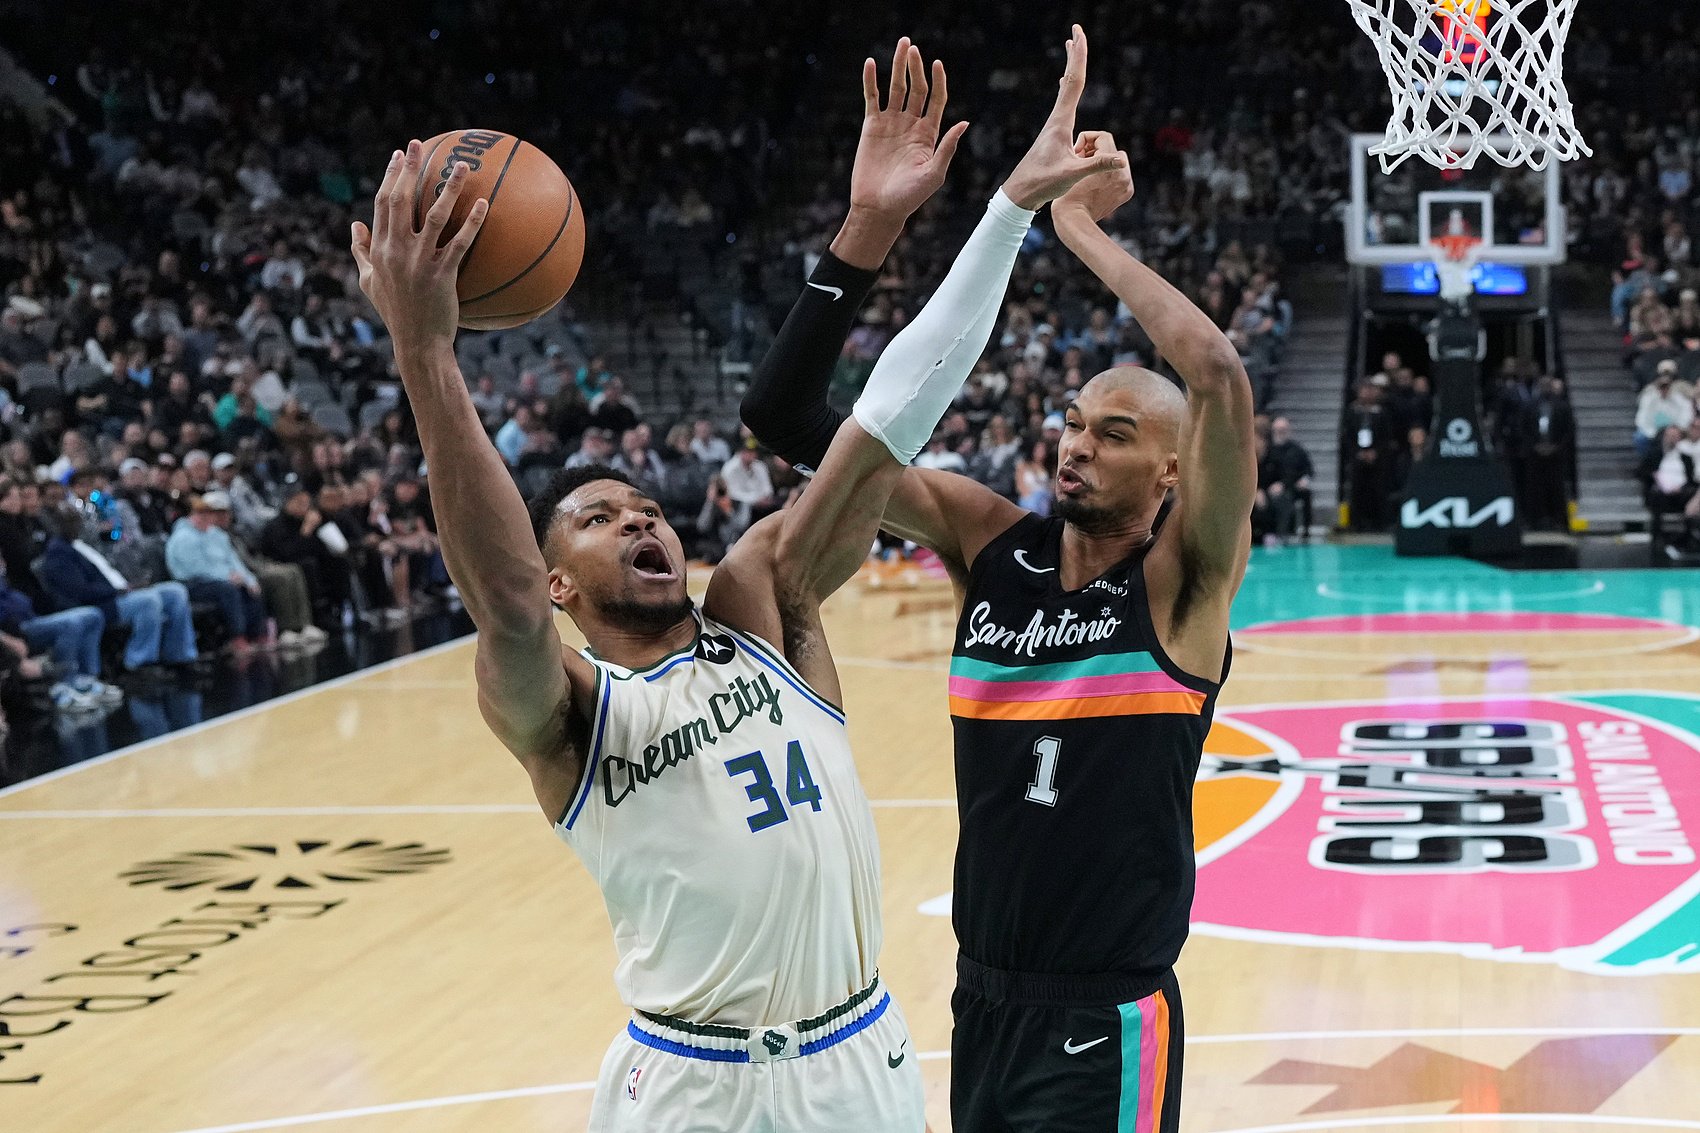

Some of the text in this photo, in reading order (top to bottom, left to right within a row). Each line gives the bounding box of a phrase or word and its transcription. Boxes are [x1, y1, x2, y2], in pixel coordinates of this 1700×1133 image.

[1401, 497, 1514, 528] KIA
[965, 601, 1122, 657] San Antonio
[602, 672, 783, 808] Cream City
[1025, 735, 1062, 807] 1
[724, 740, 822, 833] 34
[1308, 718, 1599, 875] SPURS
[1577, 720, 1697, 866] SAN ANTONIO
[765, 1034, 784, 1049] BUCKS
